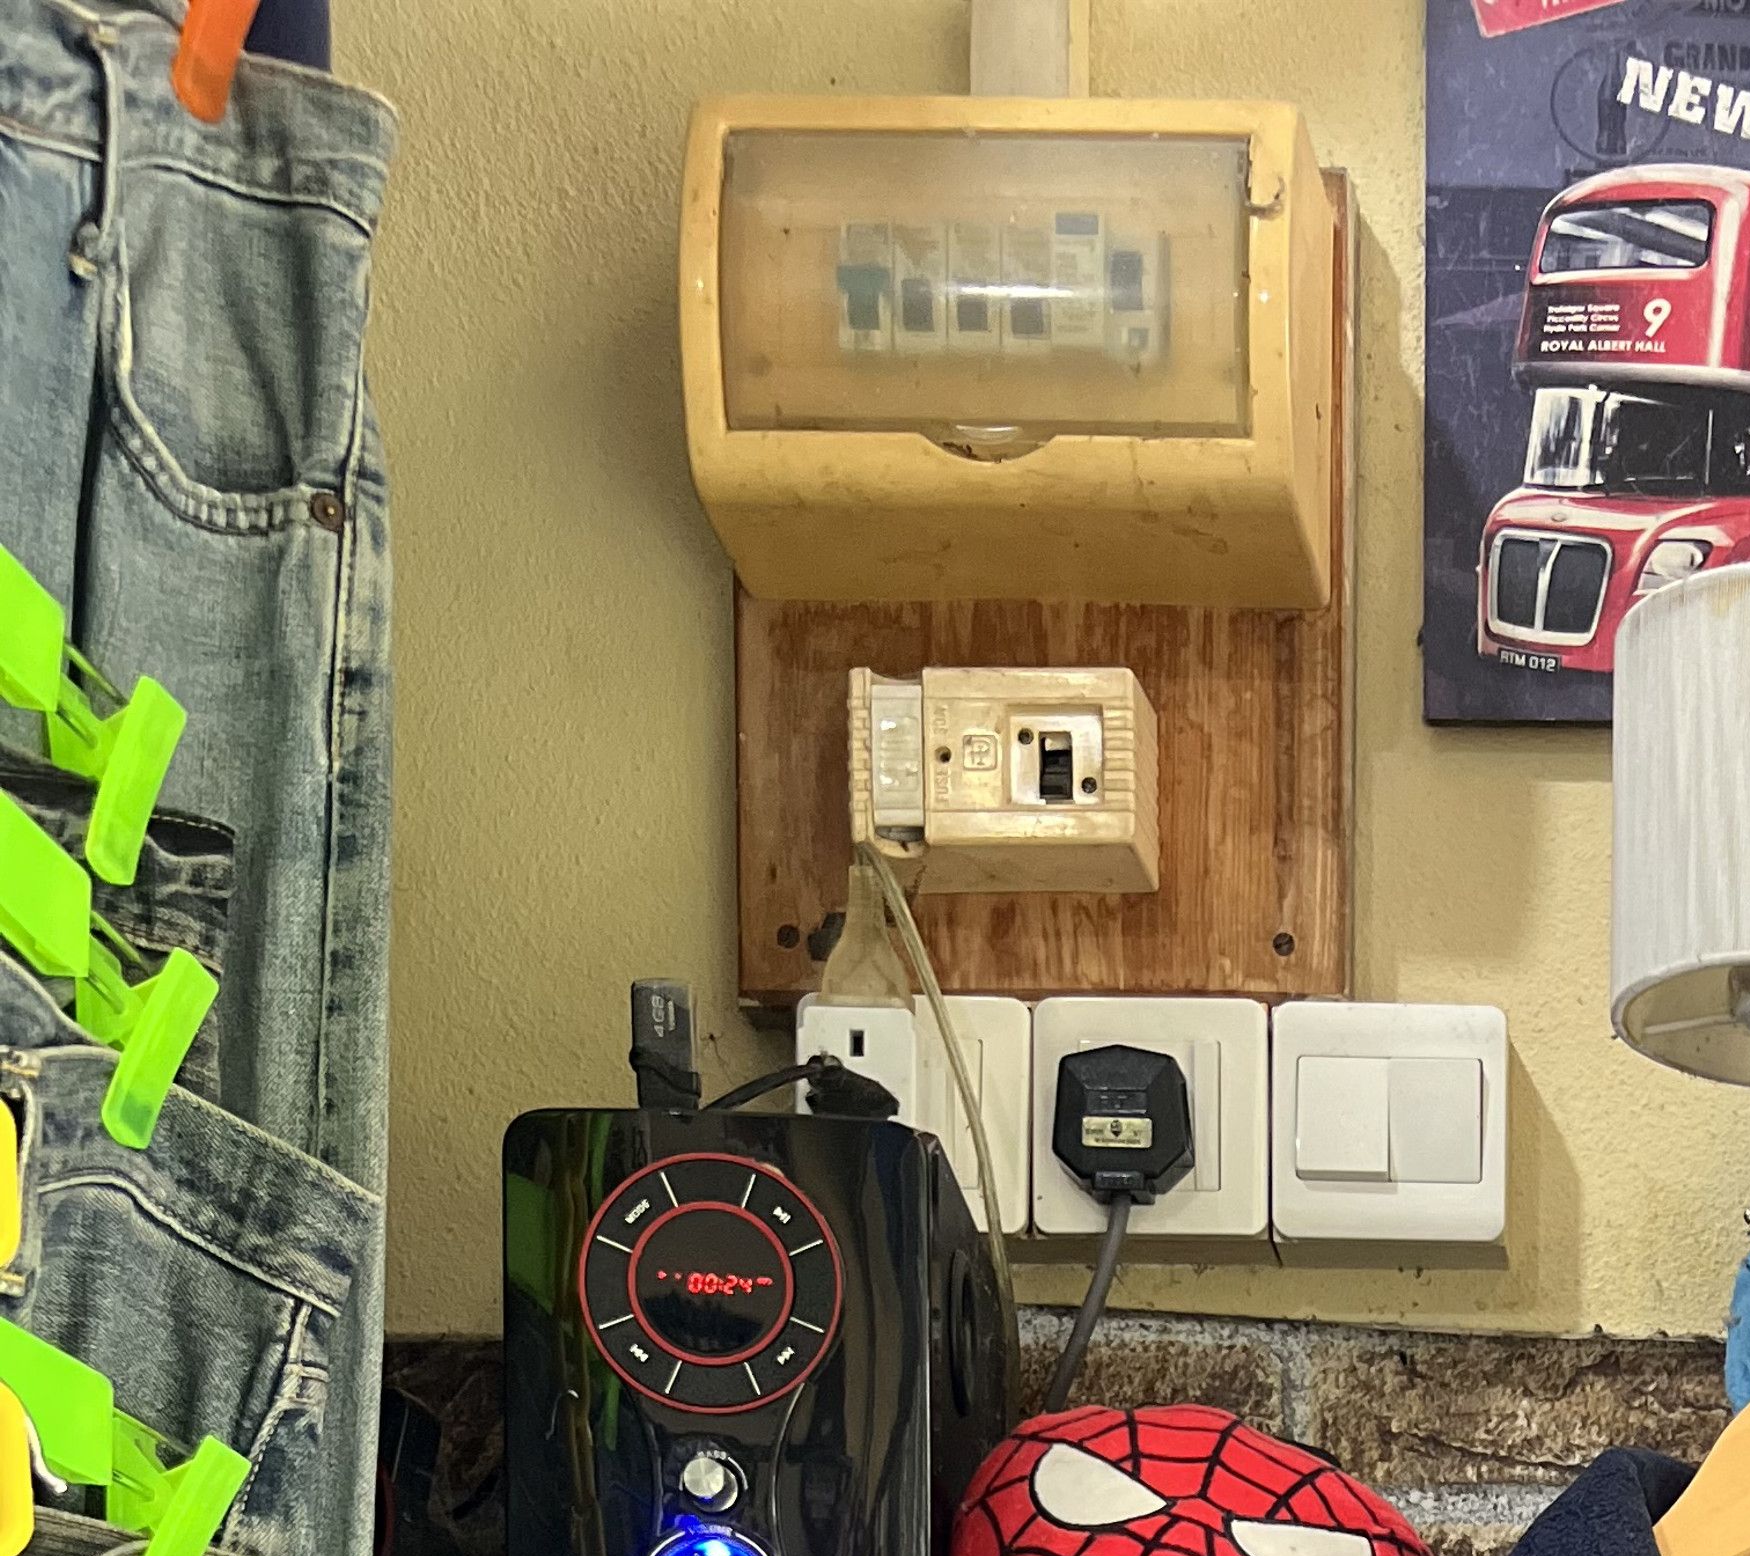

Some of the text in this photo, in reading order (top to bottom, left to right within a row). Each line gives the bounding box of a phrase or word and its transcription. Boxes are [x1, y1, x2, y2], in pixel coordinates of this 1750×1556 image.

[1643, 298, 1672, 338] 9
[1540, 339, 1666, 353] ROYAL ALBERT HALL
[687, 1272, 753, 1295] 00:24
